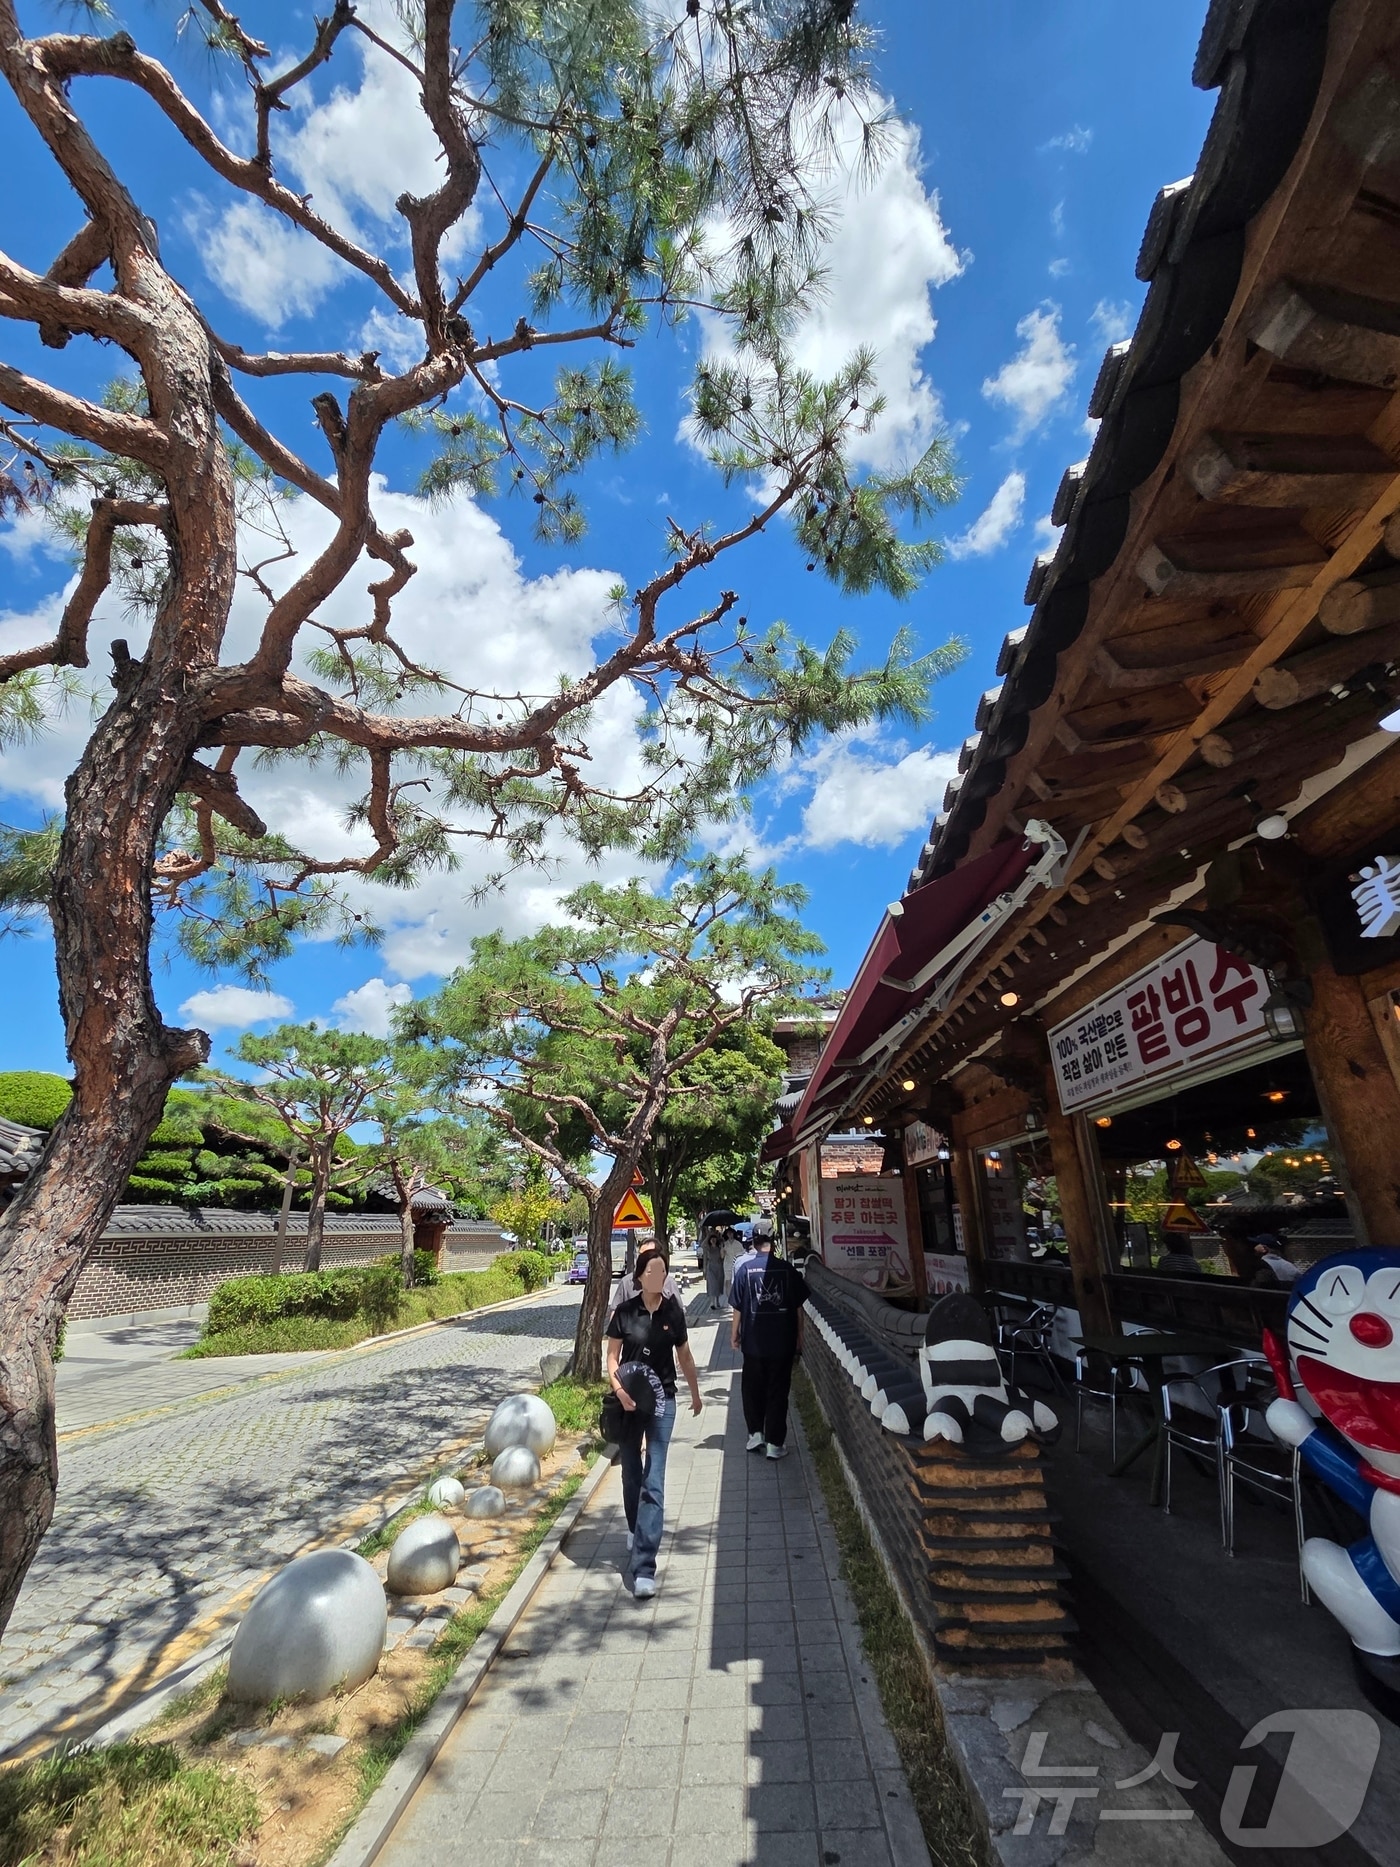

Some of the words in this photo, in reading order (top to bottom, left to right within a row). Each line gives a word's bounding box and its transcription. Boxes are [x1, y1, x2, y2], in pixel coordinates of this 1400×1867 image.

[1126, 943, 1258, 1065] 팥빙수
[1056, 1036, 1078, 1060] 100%
[1078, 1010, 1124, 1046] 국산팥으로
[1061, 1058, 1081, 1082] 직접
[1082, 1046, 1103, 1074] 삶아
[1103, 1033, 1128, 1064] 만든
[831, 1211, 856, 1225] 주문
[860, 1211, 898, 1225] 하는곳
[834, 1197, 856, 1209] 딸기
[860, 1197, 893, 1209] 찹쌀떡
